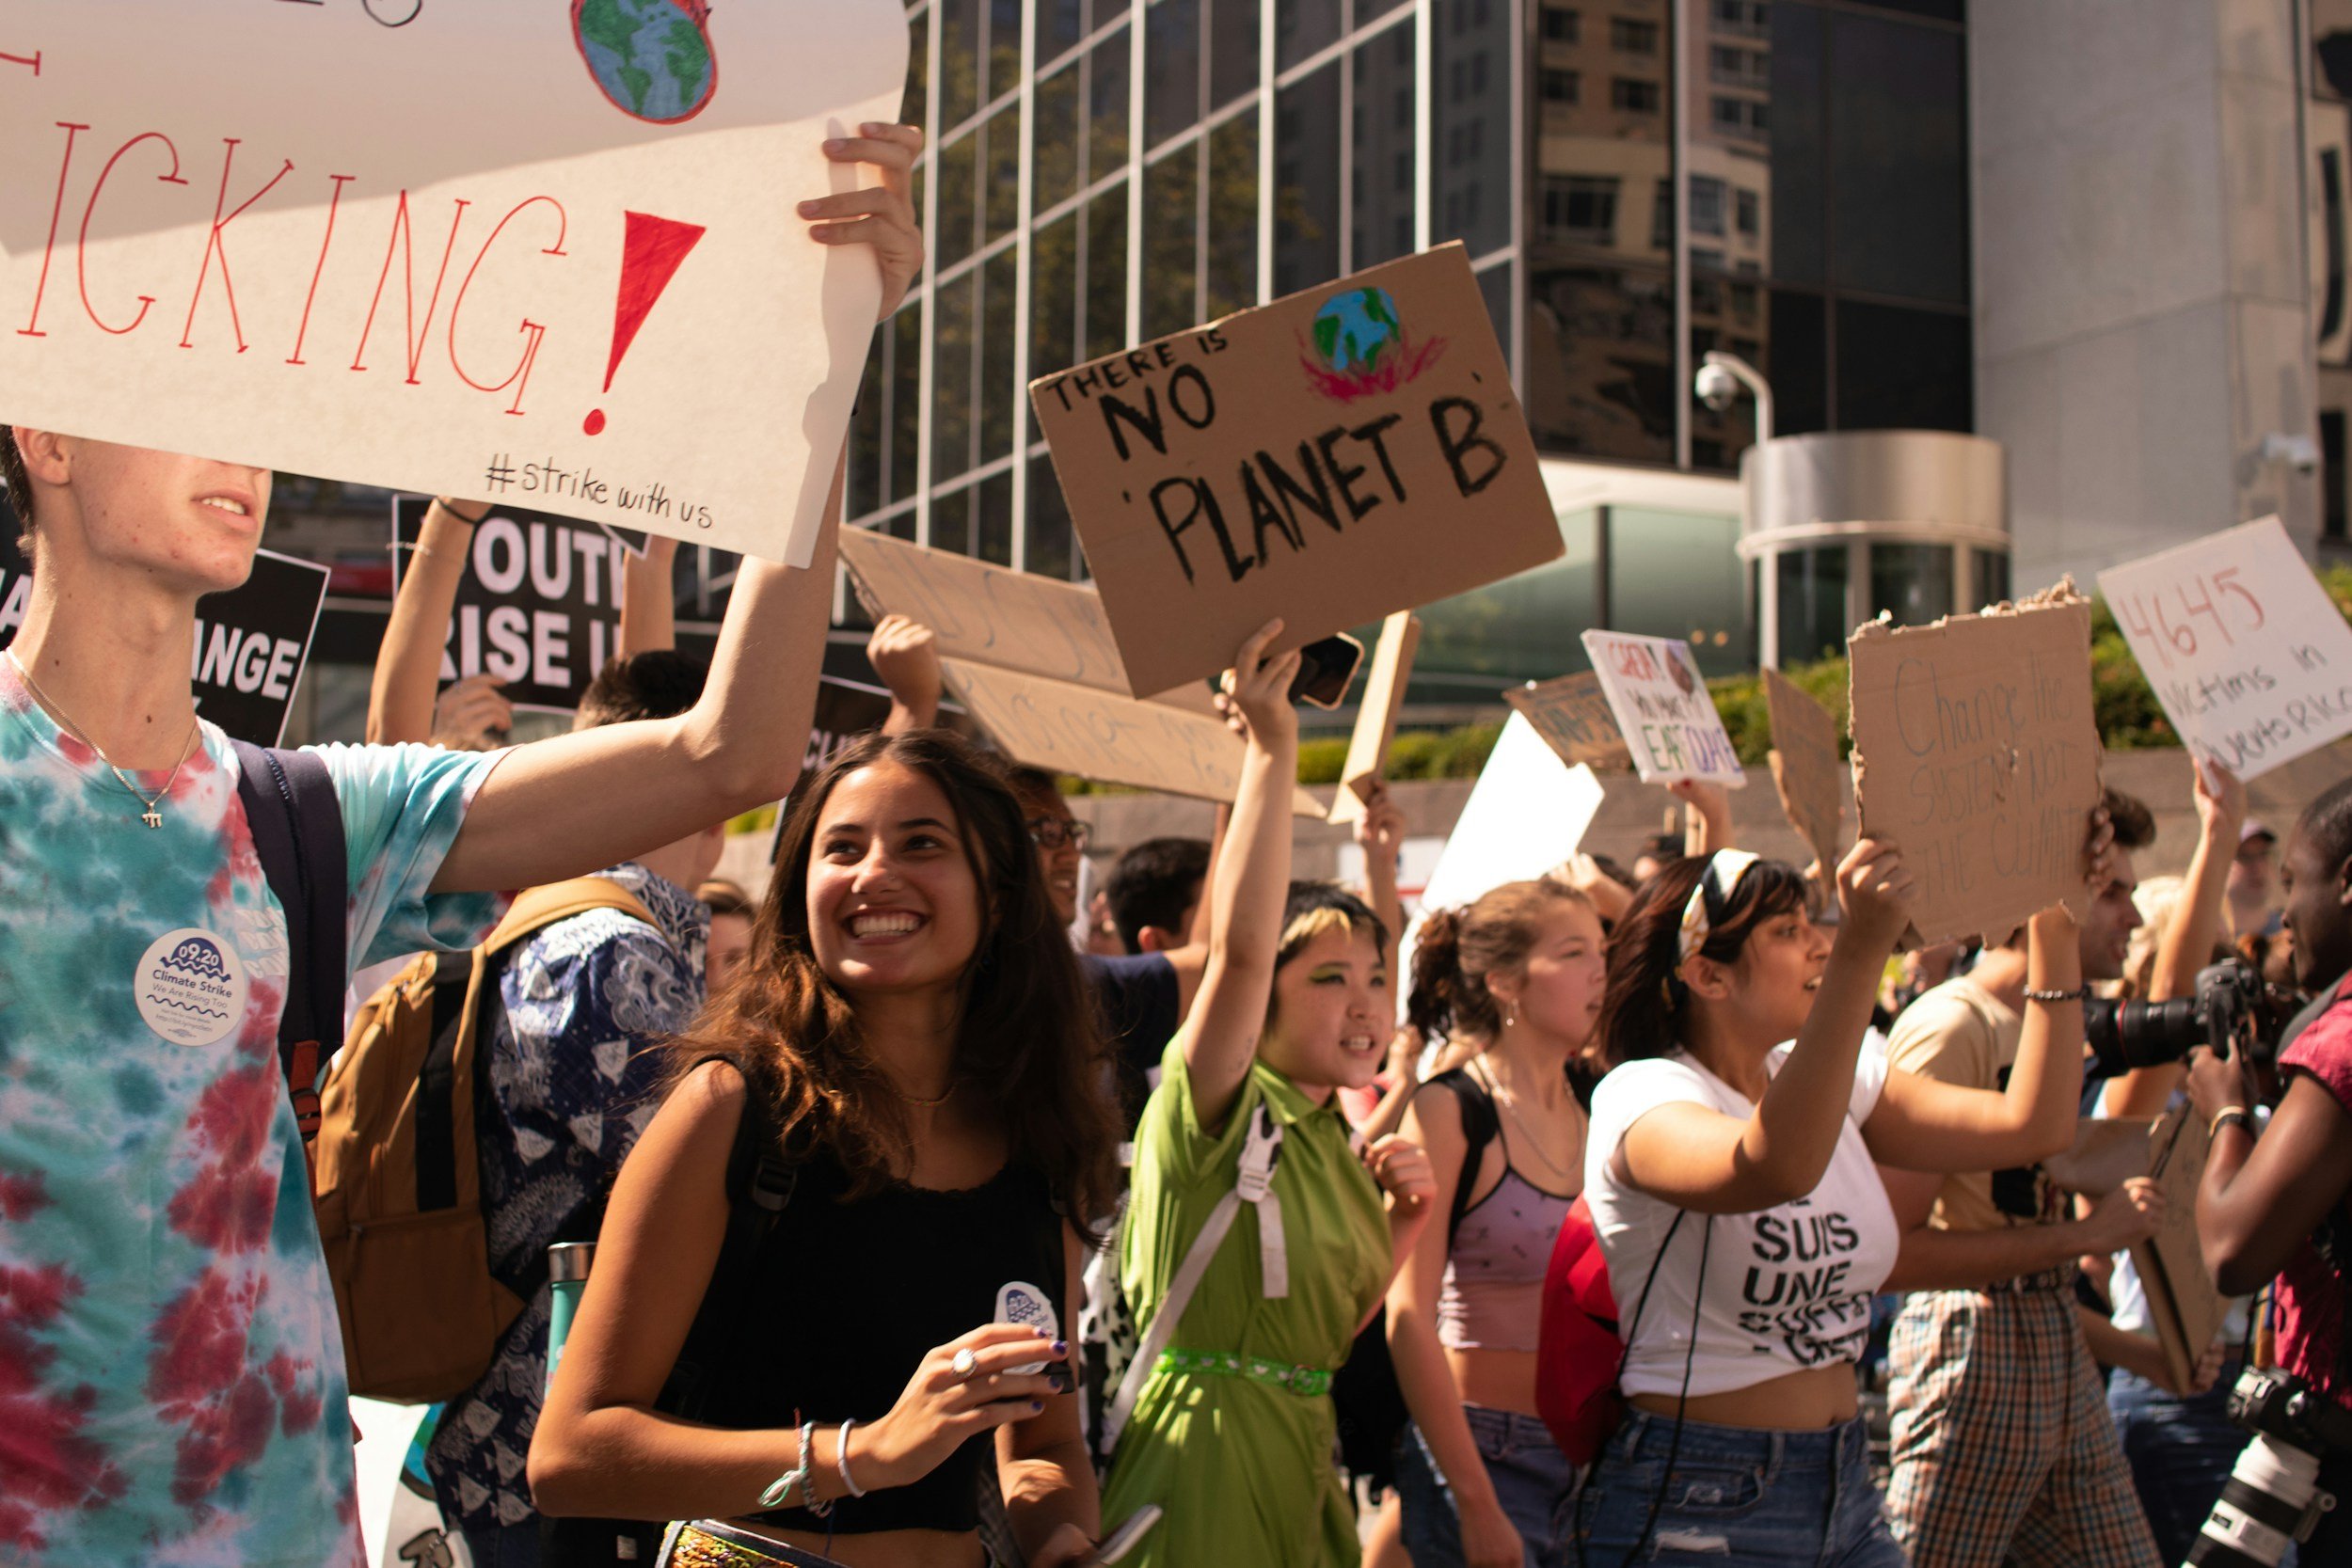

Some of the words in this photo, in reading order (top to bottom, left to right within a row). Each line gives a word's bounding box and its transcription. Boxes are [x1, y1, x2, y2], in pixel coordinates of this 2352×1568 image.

[0, 51, 707, 436] ICKING!
[1044, 341, 1175, 412] THERE
[1197, 328, 1228, 356] IS
[1098, 362, 1216, 462] NO
[485, 453, 608, 505] #strike
[616, 481, 671, 517] with
[680, 502, 714, 530] us
[2119, 565, 2265, 669] 4645
[1894, 658, 2026, 756] Change
[151, 983, 167, 993] We
[168, 987, 183, 997] Are
[152, 969, 197, 989] Climate
[199, 981, 232, 998] Strike
[179, 943, 219, 967] 09.20
[1752, 1212, 1860, 1262] SUIS
[1742, 1259, 1852, 1307] UNE
